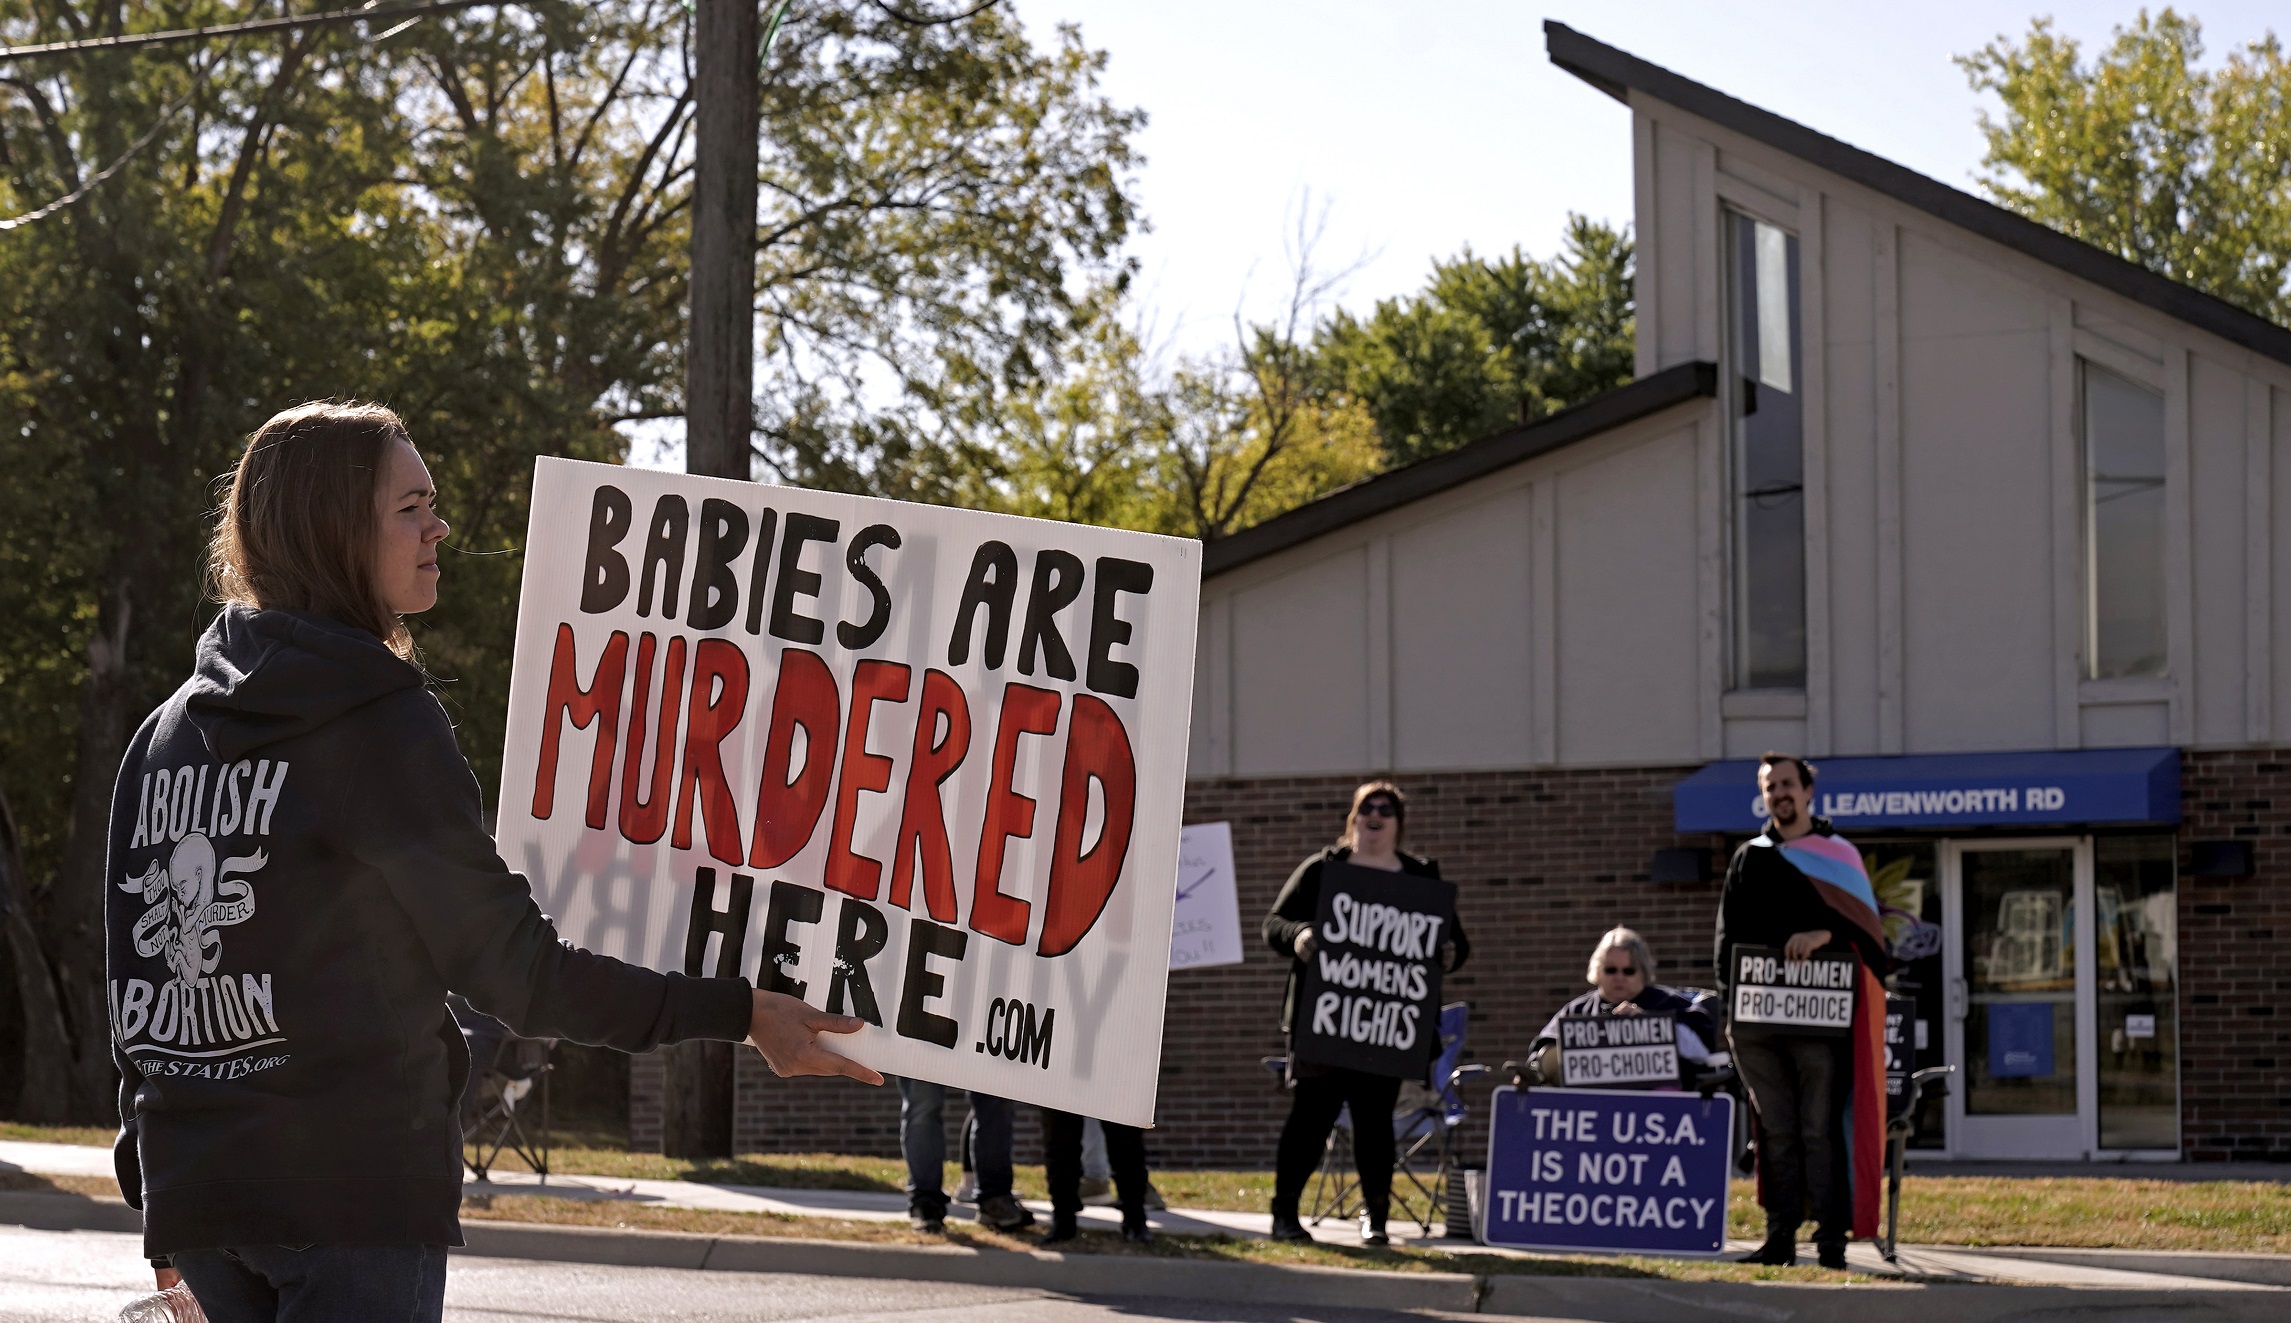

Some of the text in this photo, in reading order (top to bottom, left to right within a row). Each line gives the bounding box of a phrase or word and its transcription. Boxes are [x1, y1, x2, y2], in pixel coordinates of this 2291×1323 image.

[579, 485, 1153, 699] BABIES ARE
[129, 759, 290, 849] ABOLISH
[531, 622, 1137, 959] MURDERED
[1822, 788, 2018, 817] LEAVENWORTH
[2025, 787, 2066, 811] RD
[147, 874, 165, 902] THOU
[141, 904, 166, 929] SHALT
[198, 901, 254, 927] MURDER.
[1322, 891, 1444, 960] SUPPORT
[150, 928, 166, 953] NOT
[684, 866, 969, 1050] HERE
[975, 997, 1056, 1071] .COM
[1740, 955, 1854, 989] PRO-WOMEN
[110, 972, 280, 1046] ABORTION
[1312, 991, 1421, 1051] RIGHTS
[1740, 992, 1849, 1021] PRO-CHOICE
[1562, 1016, 1674, 1048] PRO-WOMEN
[1568, 1050, 1674, 1079] PRO-CHOICE
[1530, 1108, 1706, 1146] THE U.S.A.
[1530, 1150, 1686, 1187] IS NOT A
[1498, 1190, 1715, 1230] THEOCRACY
